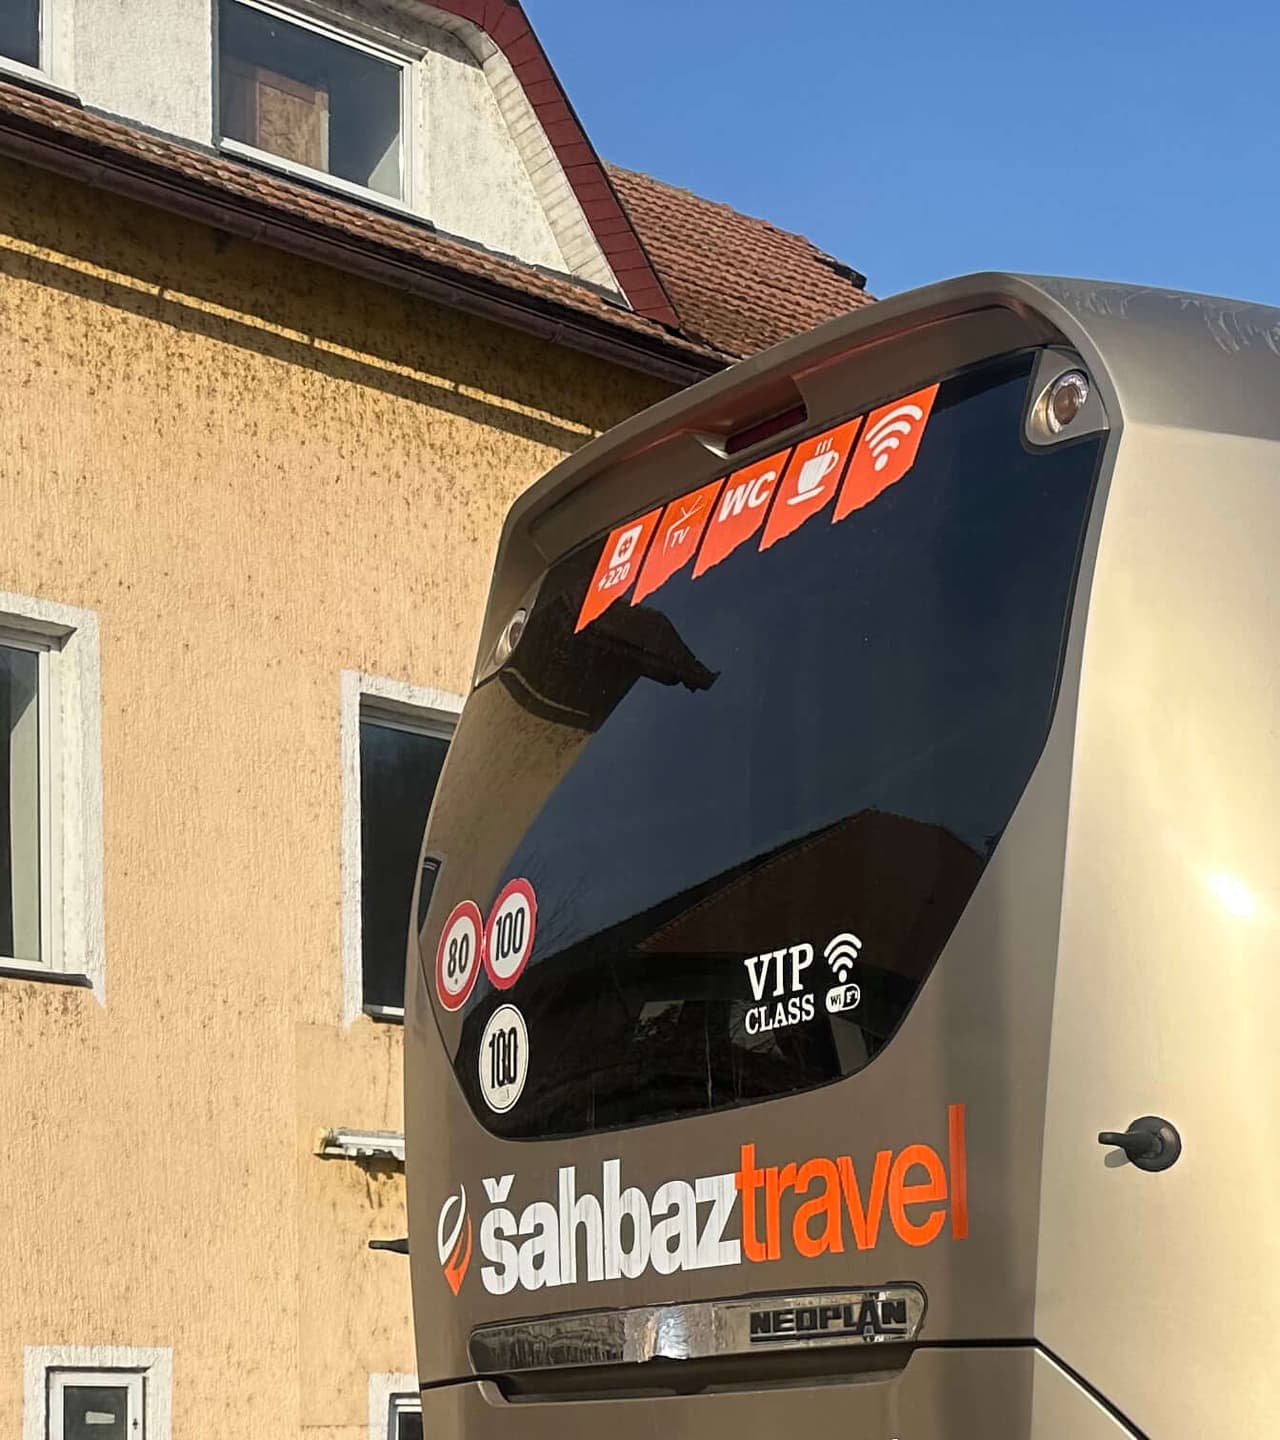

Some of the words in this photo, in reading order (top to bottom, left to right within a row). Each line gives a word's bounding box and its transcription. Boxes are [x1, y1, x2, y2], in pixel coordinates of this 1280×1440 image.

[720, 472, 776, 522] WC
[671, 526, 690, 547] TV
[447, 932, 470, 979] 80
[495, 906, 526, 962] 100
[744, 943, 814, 1001] VIP
[745, 993, 815, 1035] CLASS
[488, 1026, 518, 1089] 100
[750, 1294, 907, 1340] NEOPLAN
